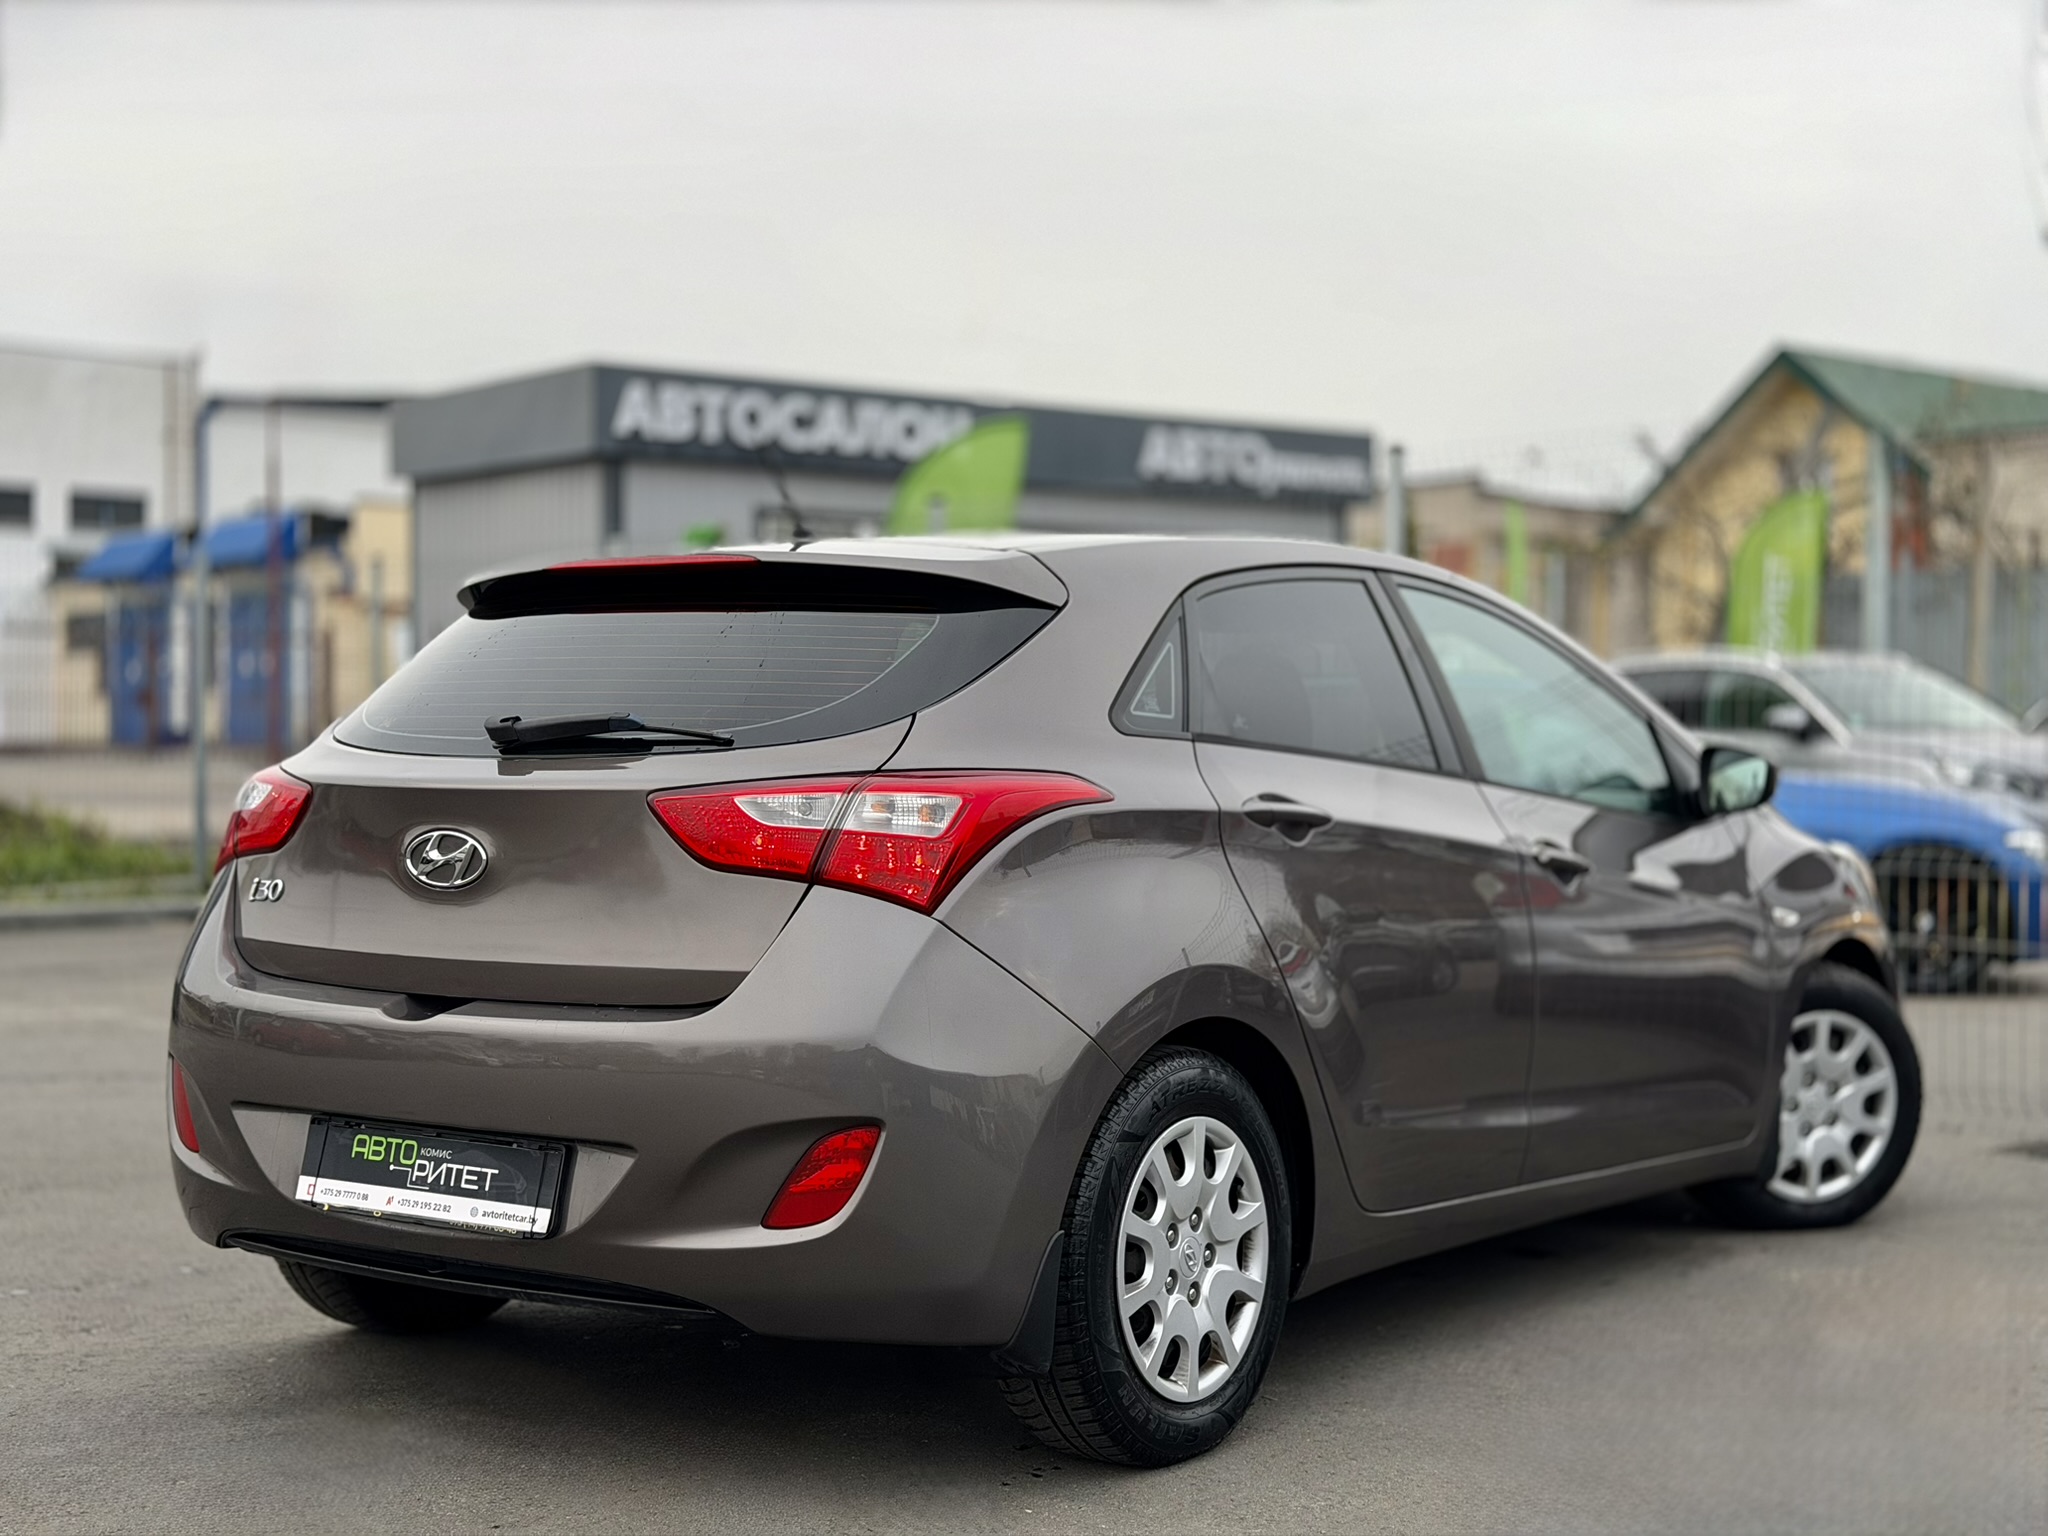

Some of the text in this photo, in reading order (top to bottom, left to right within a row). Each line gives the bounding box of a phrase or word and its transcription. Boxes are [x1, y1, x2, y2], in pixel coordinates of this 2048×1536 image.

[249, 877, 285, 903] i30
[351, 1133, 418, 1165] АВТО
[420, 1147, 453, 1160] КОМИС
[412, 1159, 499, 1192] РИТЕТ
[320, 1188, 334, 1197] +375
[334, 1189, 342, 1197] 29
[342, 1190, 357, 1200] 7777
[356, 1192, 361, 1200] 0
[397, 1198, 452, 1213] +375 29 195 22 82
[481, 1209, 539, 1225] avtoritetcar.by
